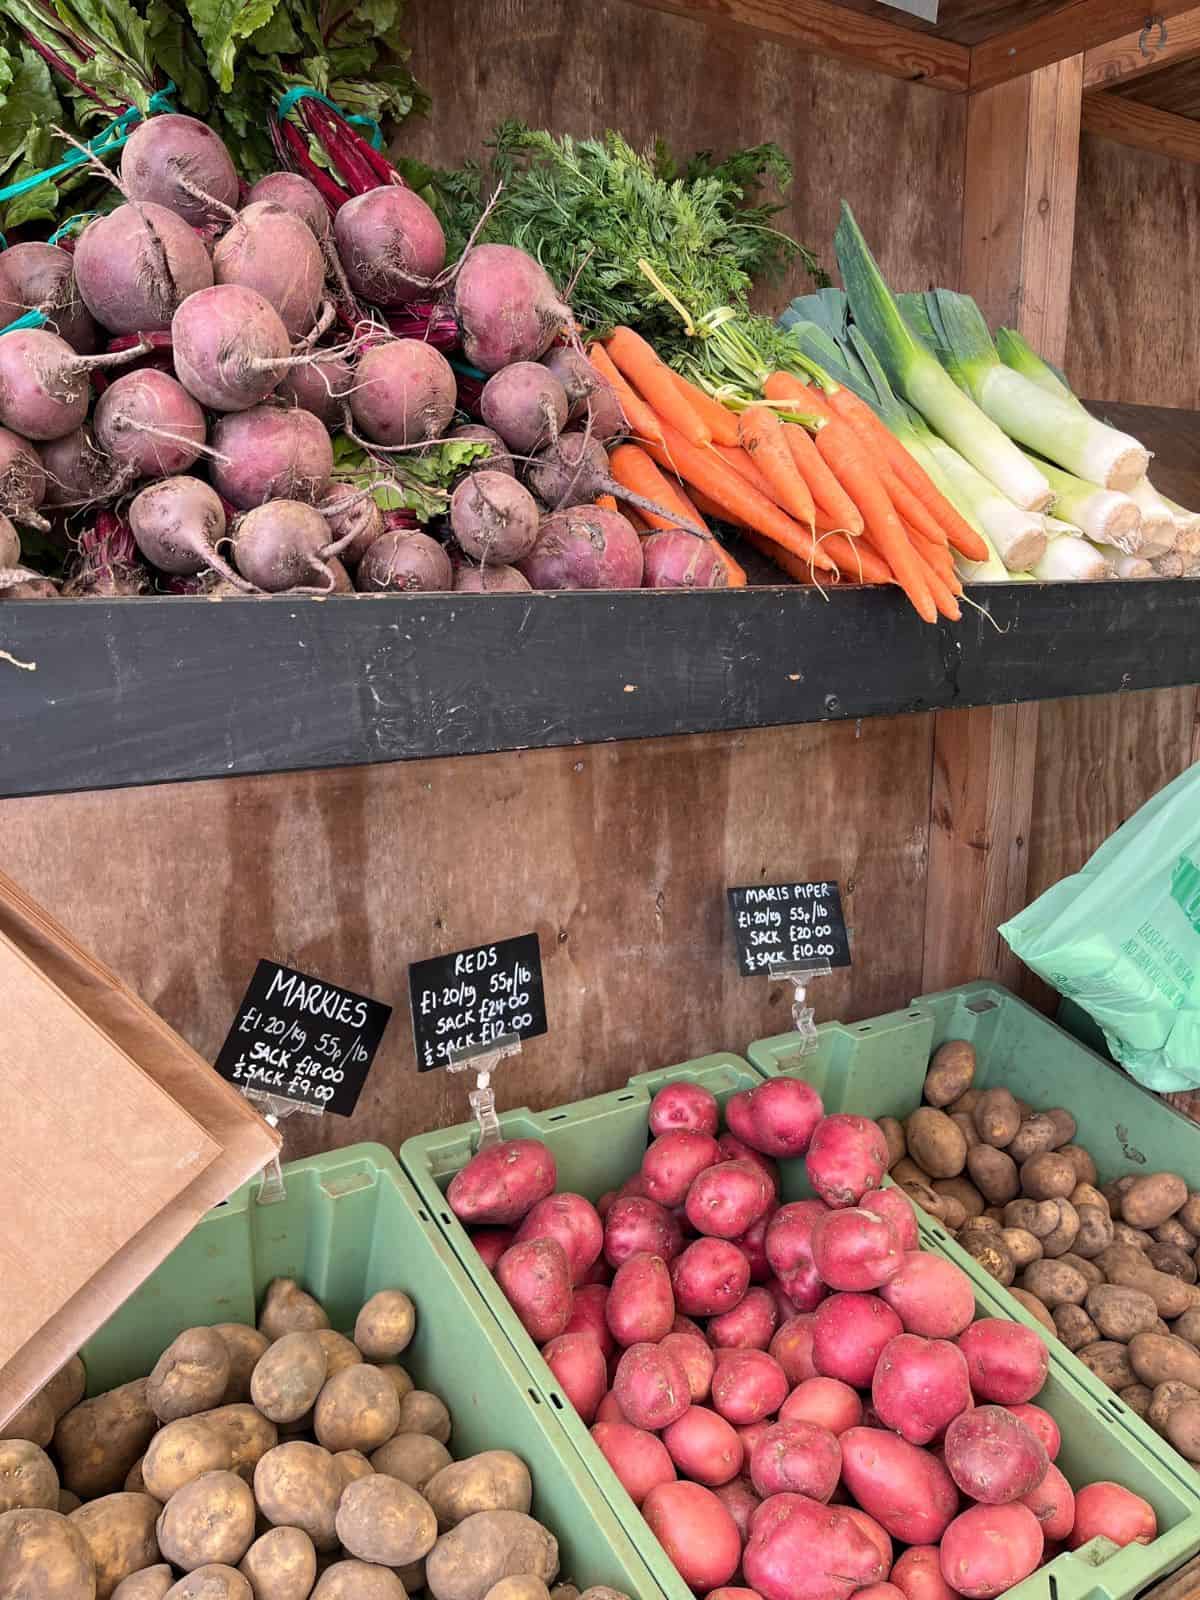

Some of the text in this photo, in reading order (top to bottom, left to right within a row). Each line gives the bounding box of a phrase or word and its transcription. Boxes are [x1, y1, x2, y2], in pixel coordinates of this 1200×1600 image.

[746, 883, 830, 904] MARIS PIPER
[750, 930, 781, 946] SACK
[455, 947, 497, 976] REDS
[265, 969, 368, 1028] MARKIES
[436, 1010, 476, 1034] SACK
[250, 1042, 291, 1068] SACK
